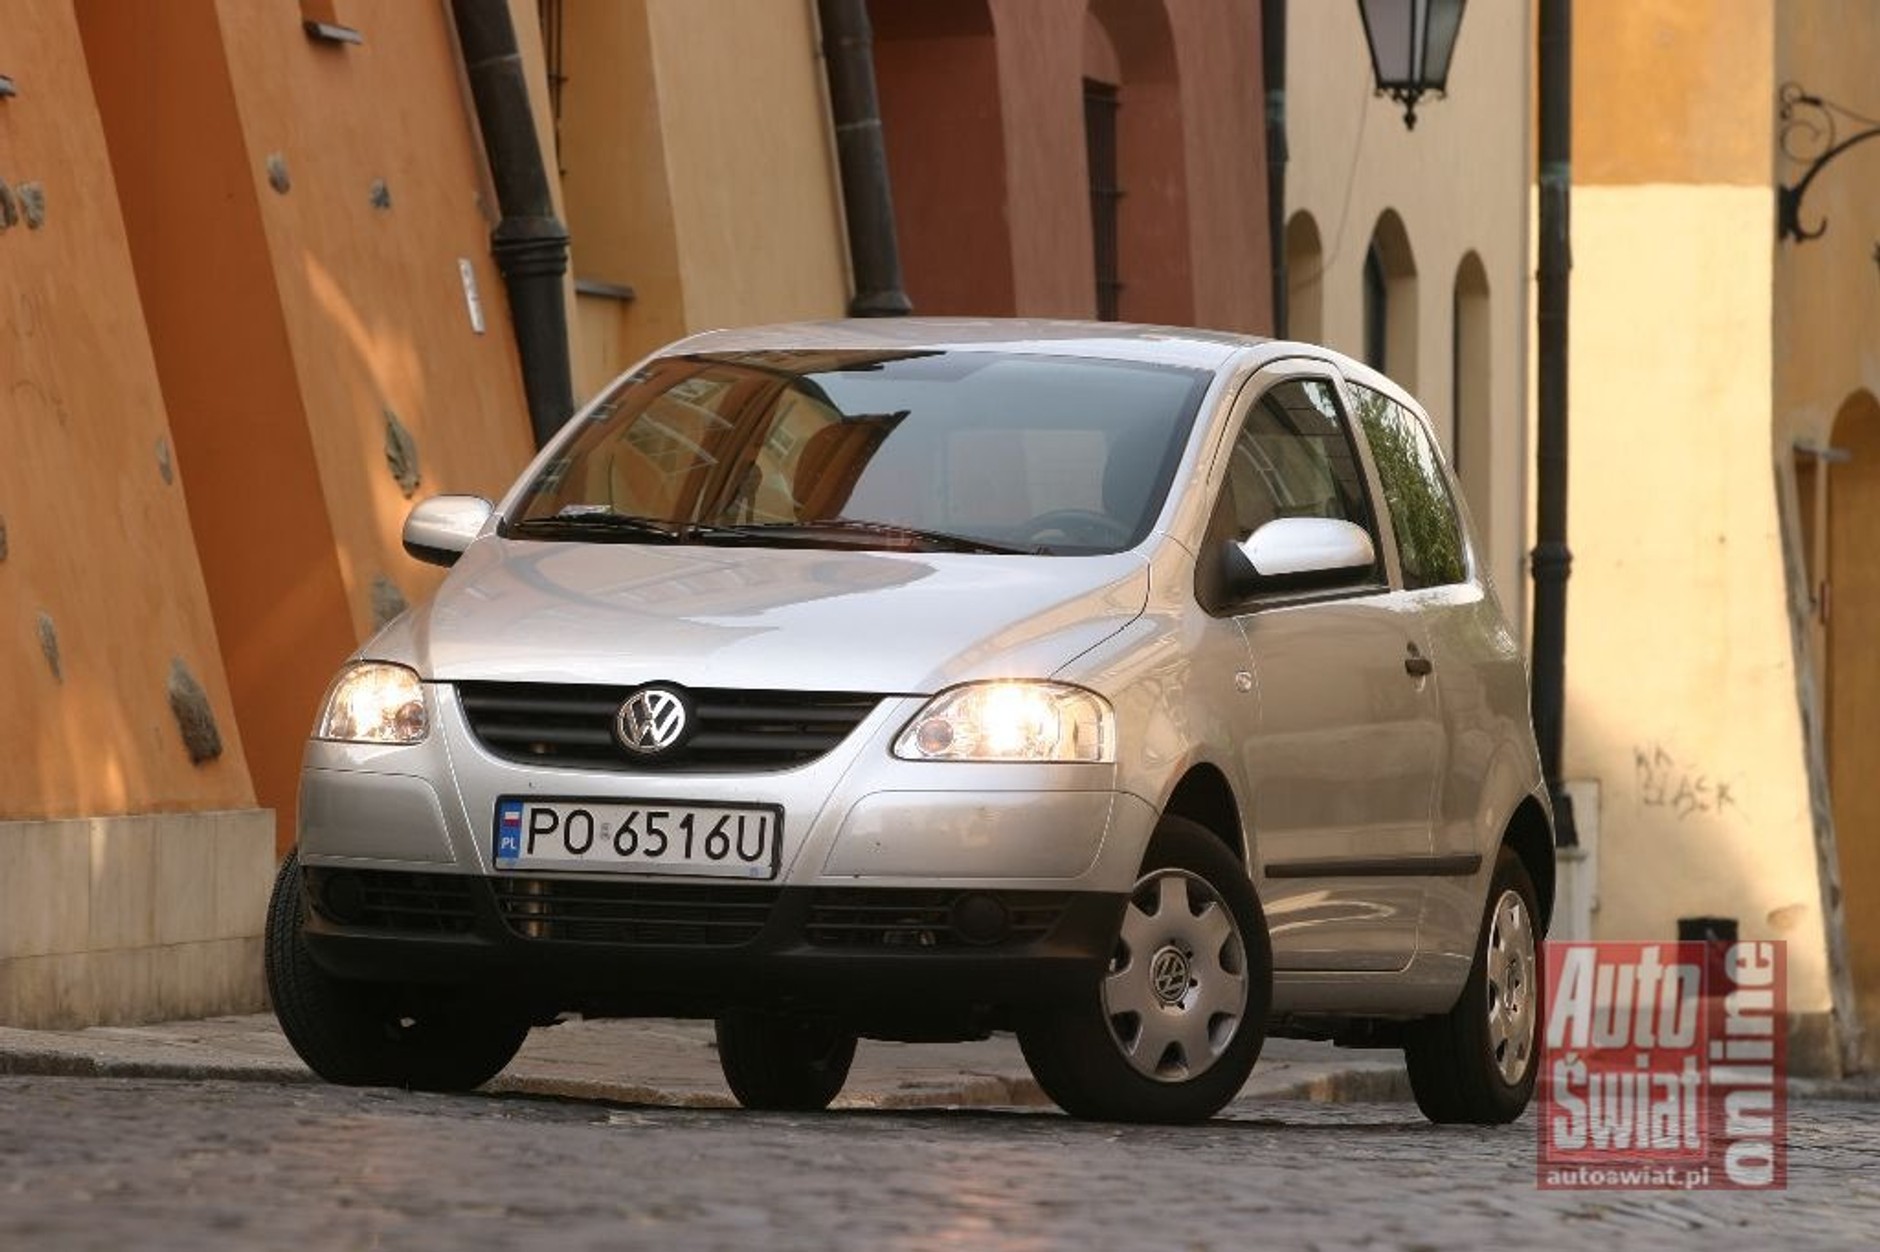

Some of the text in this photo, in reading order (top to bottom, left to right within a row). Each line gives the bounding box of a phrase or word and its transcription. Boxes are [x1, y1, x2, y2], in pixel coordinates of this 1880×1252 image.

[618, 690, 686, 752] VW
[501, 836, 517, 850] PL
[526, 807, 767, 862] PO 6516U
